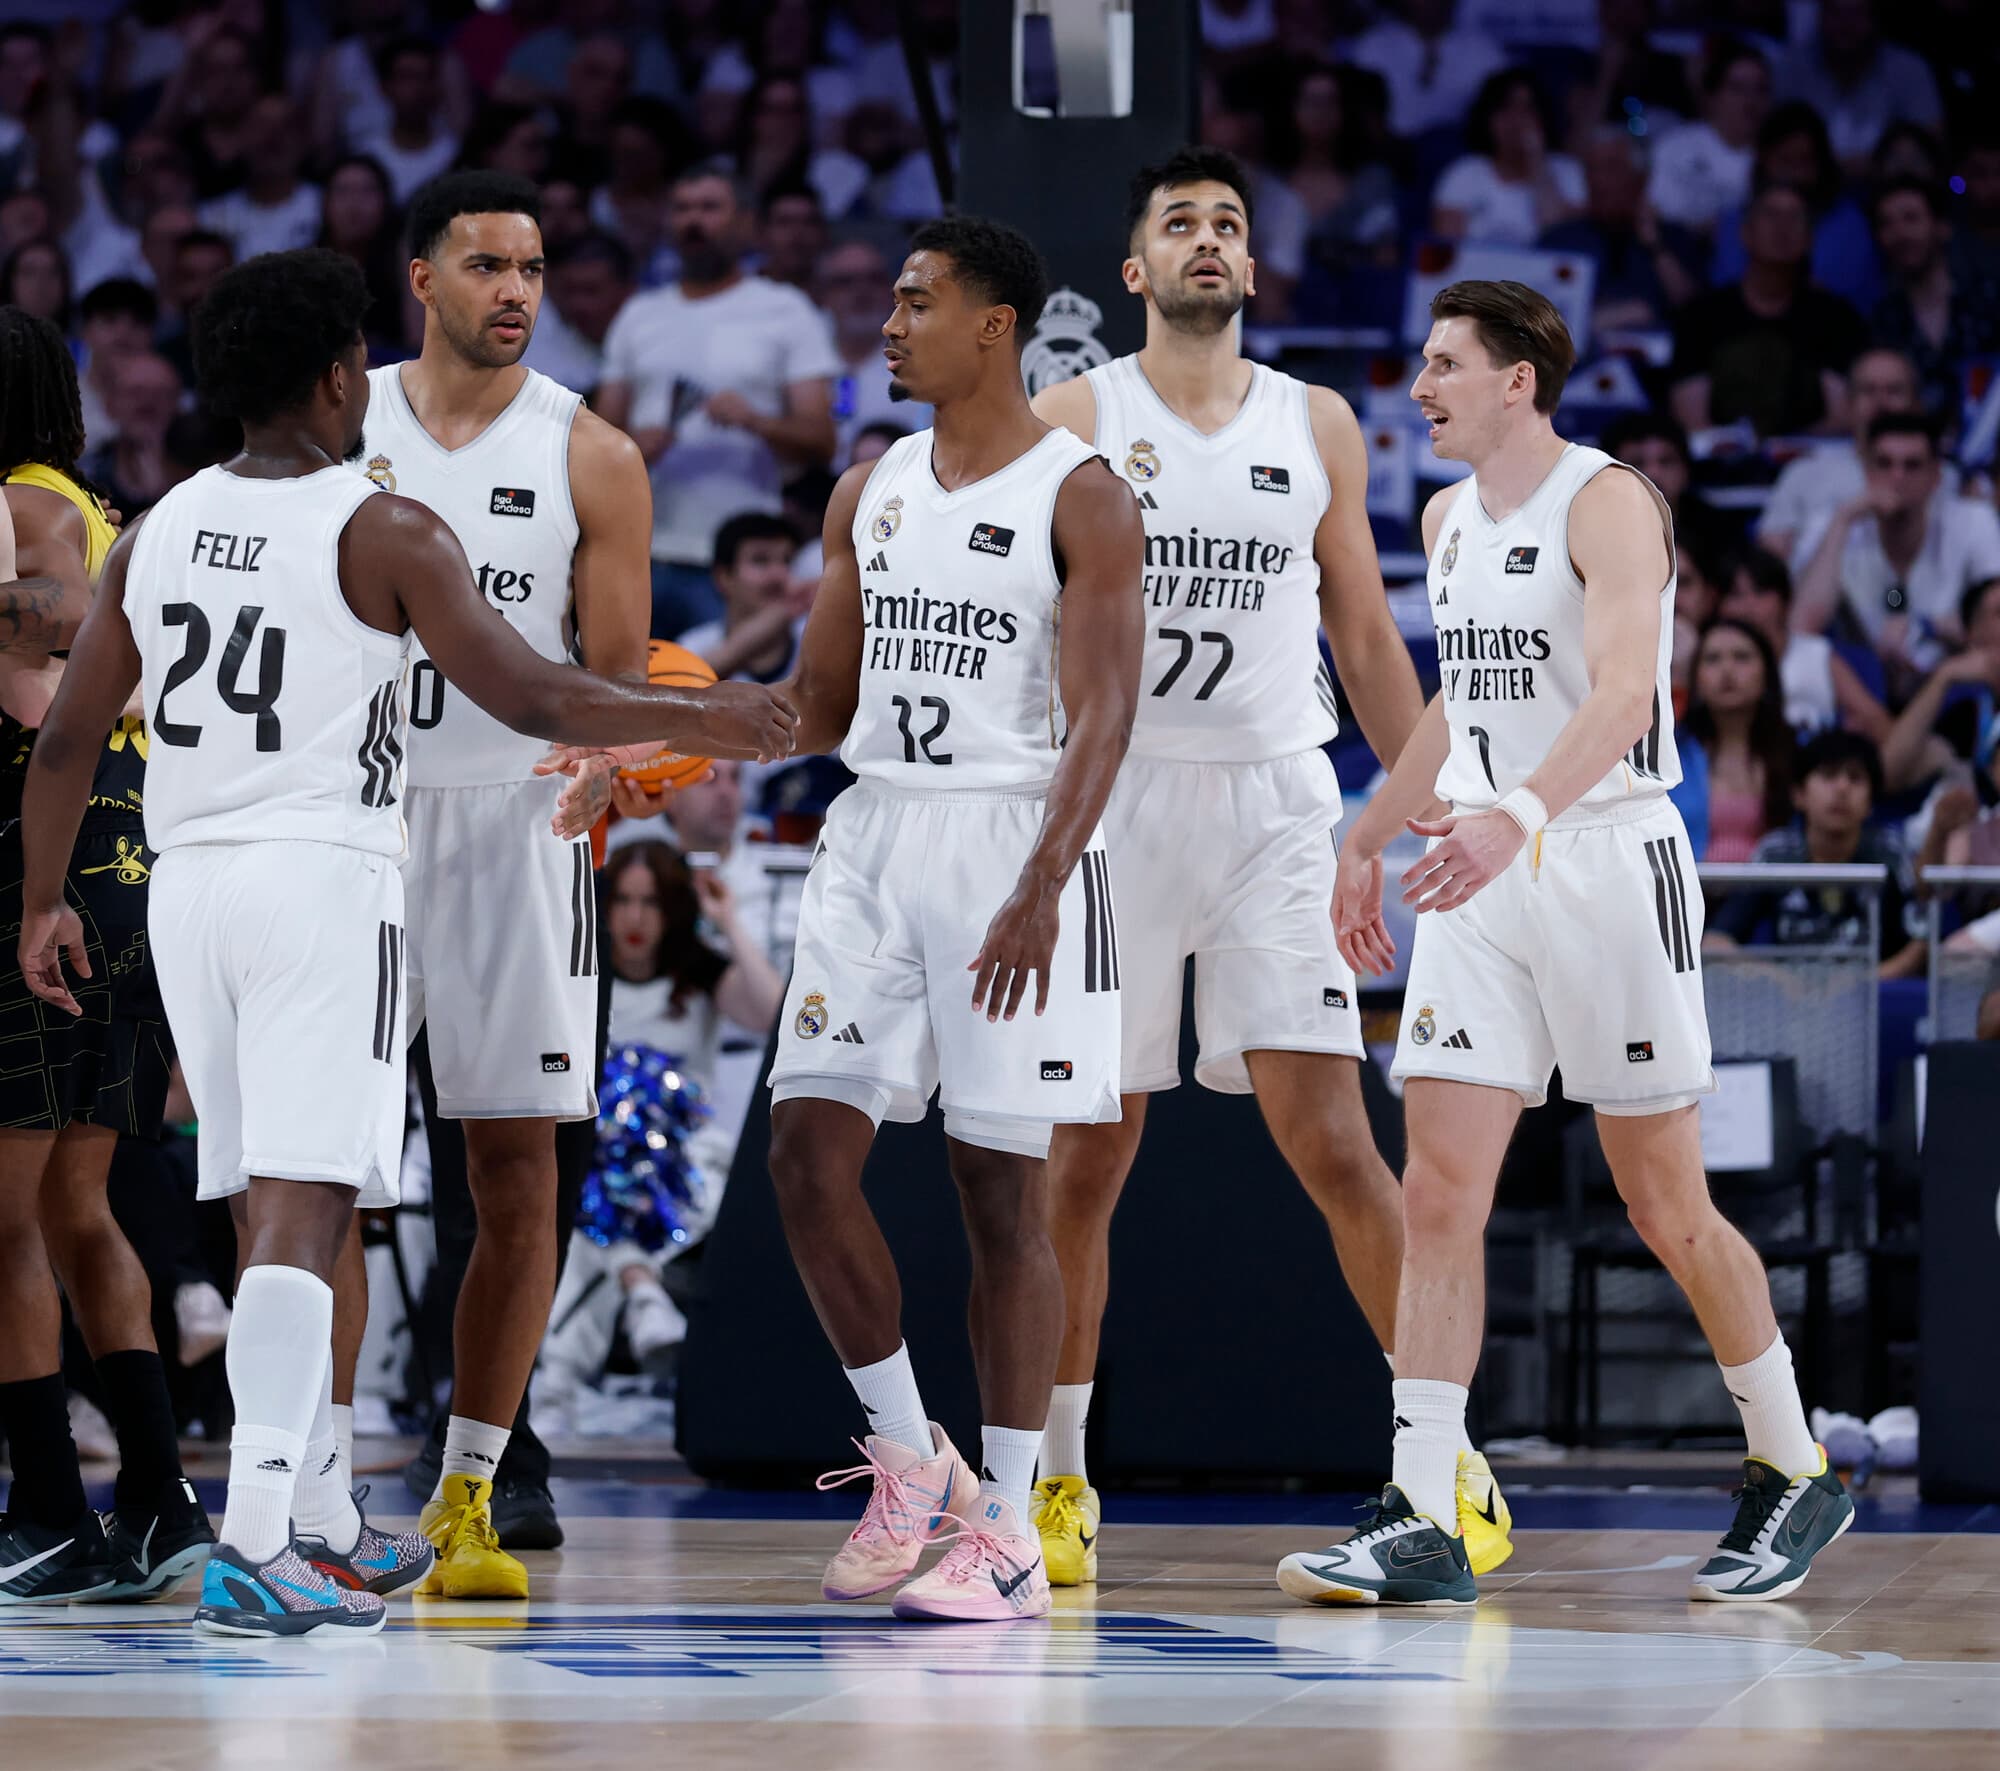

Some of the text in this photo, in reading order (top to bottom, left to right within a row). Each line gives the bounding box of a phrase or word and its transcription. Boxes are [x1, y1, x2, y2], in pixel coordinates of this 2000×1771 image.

[494, 494, 512, 505] liga
[192, 529, 267, 572] FELIZ
[972, 540, 1007, 554] endesa
[1144, 527, 1294, 574] mirates
[1185, 576, 1265, 612] BETTER
[1435, 618, 1551, 662] mirates
[153, 601, 287, 752] 24
[870, 637, 987, 680] FLY BETTER
[1151, 628, 1234, 701] 77
[1468, 667, 1536, 701] BETTER
[891, 695, 953, 765] 12
[544, 1060, 565, 1071] acb
[1043, 1067, 1067, 1079] acb
[1629, 1050, 1647, 1060] acb
[256, 1464, 293, 1473] adidas
